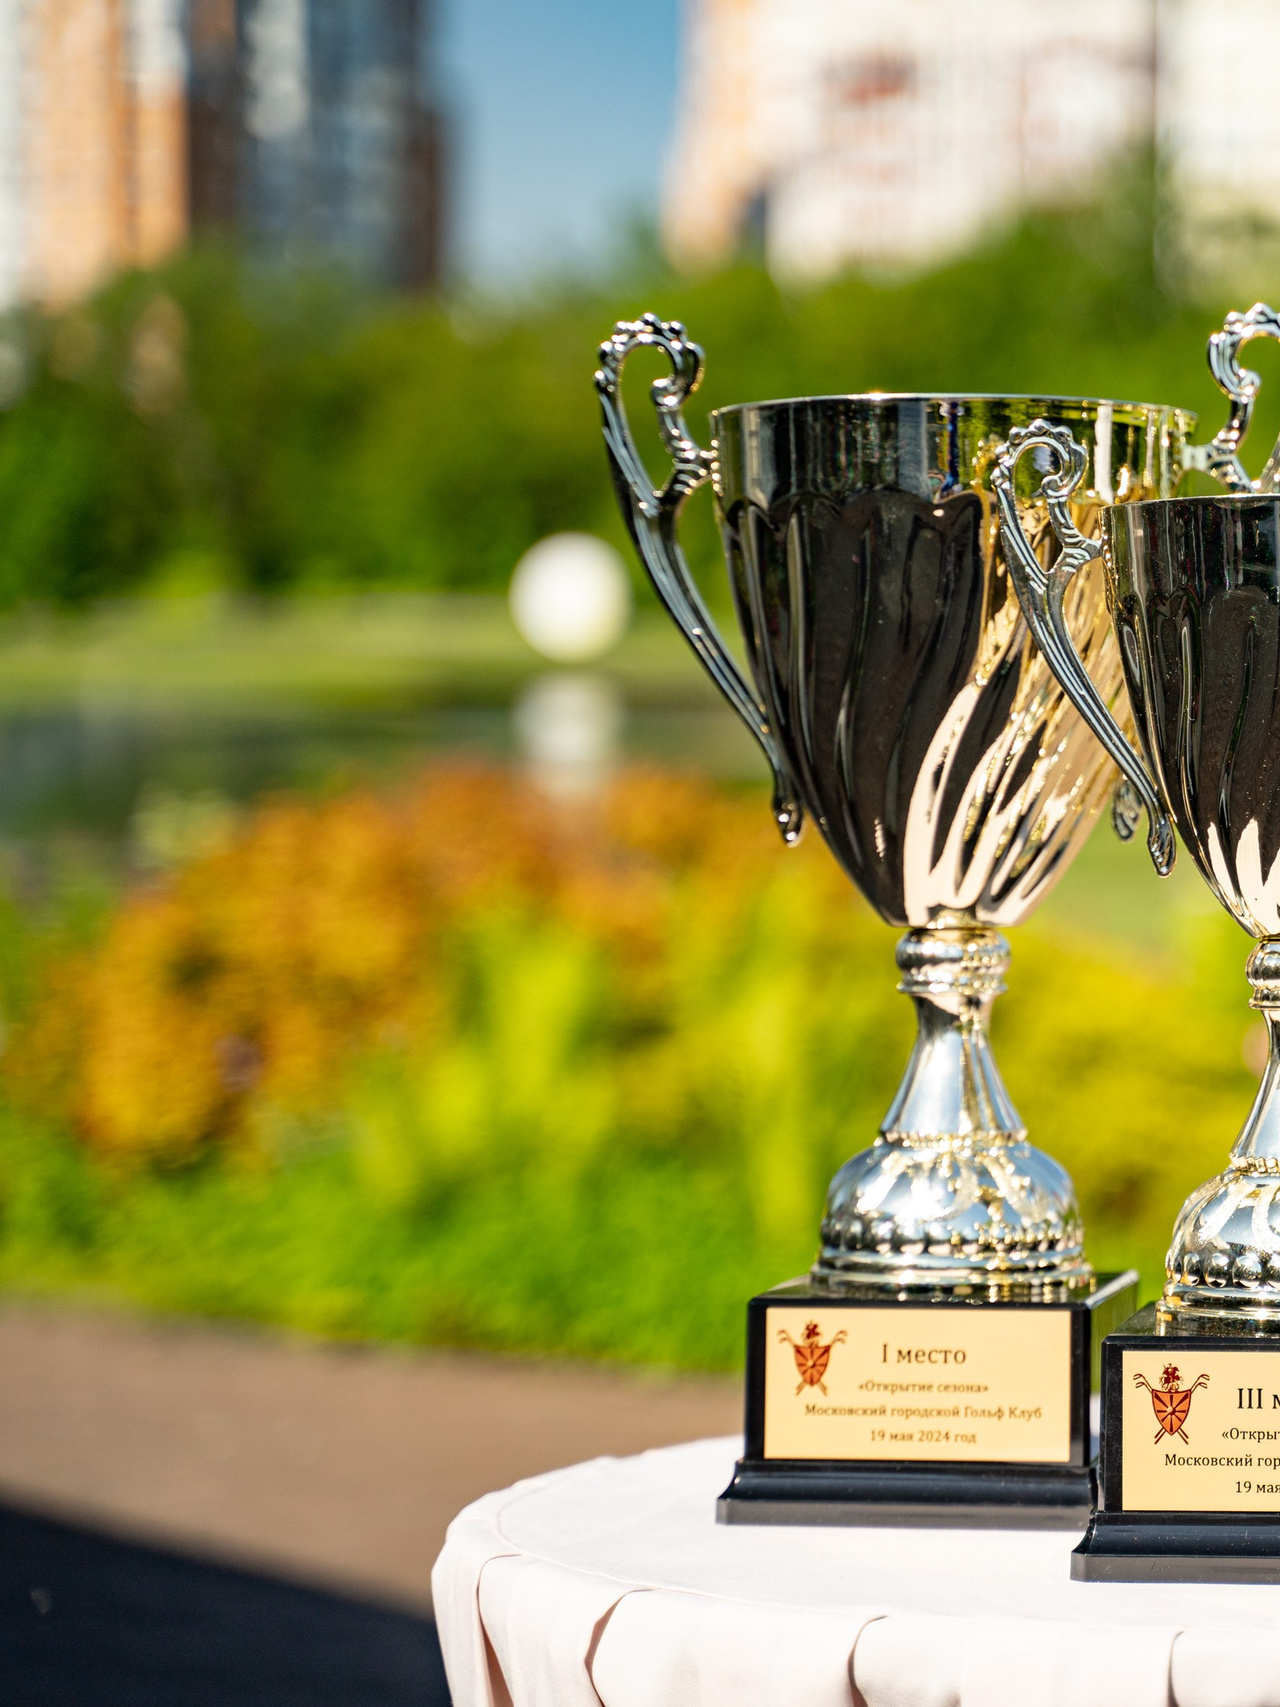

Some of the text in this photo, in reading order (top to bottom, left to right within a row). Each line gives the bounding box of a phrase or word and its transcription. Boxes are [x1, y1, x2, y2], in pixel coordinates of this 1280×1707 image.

[882, 1343, 967, 1365] I место
[857, 1379, 990, 1395] «Открытие сезона»
[1237, 1387, 1263, 1410] III
[804, 1403, 1043, 1422] Московский городской Гольф Клуб
[870, 1429, 977, 1445] 19 мая 2024 год
[1164, 1453, 1253, 1467] Московский
[1235, 1480, 1252, 1494] 19
